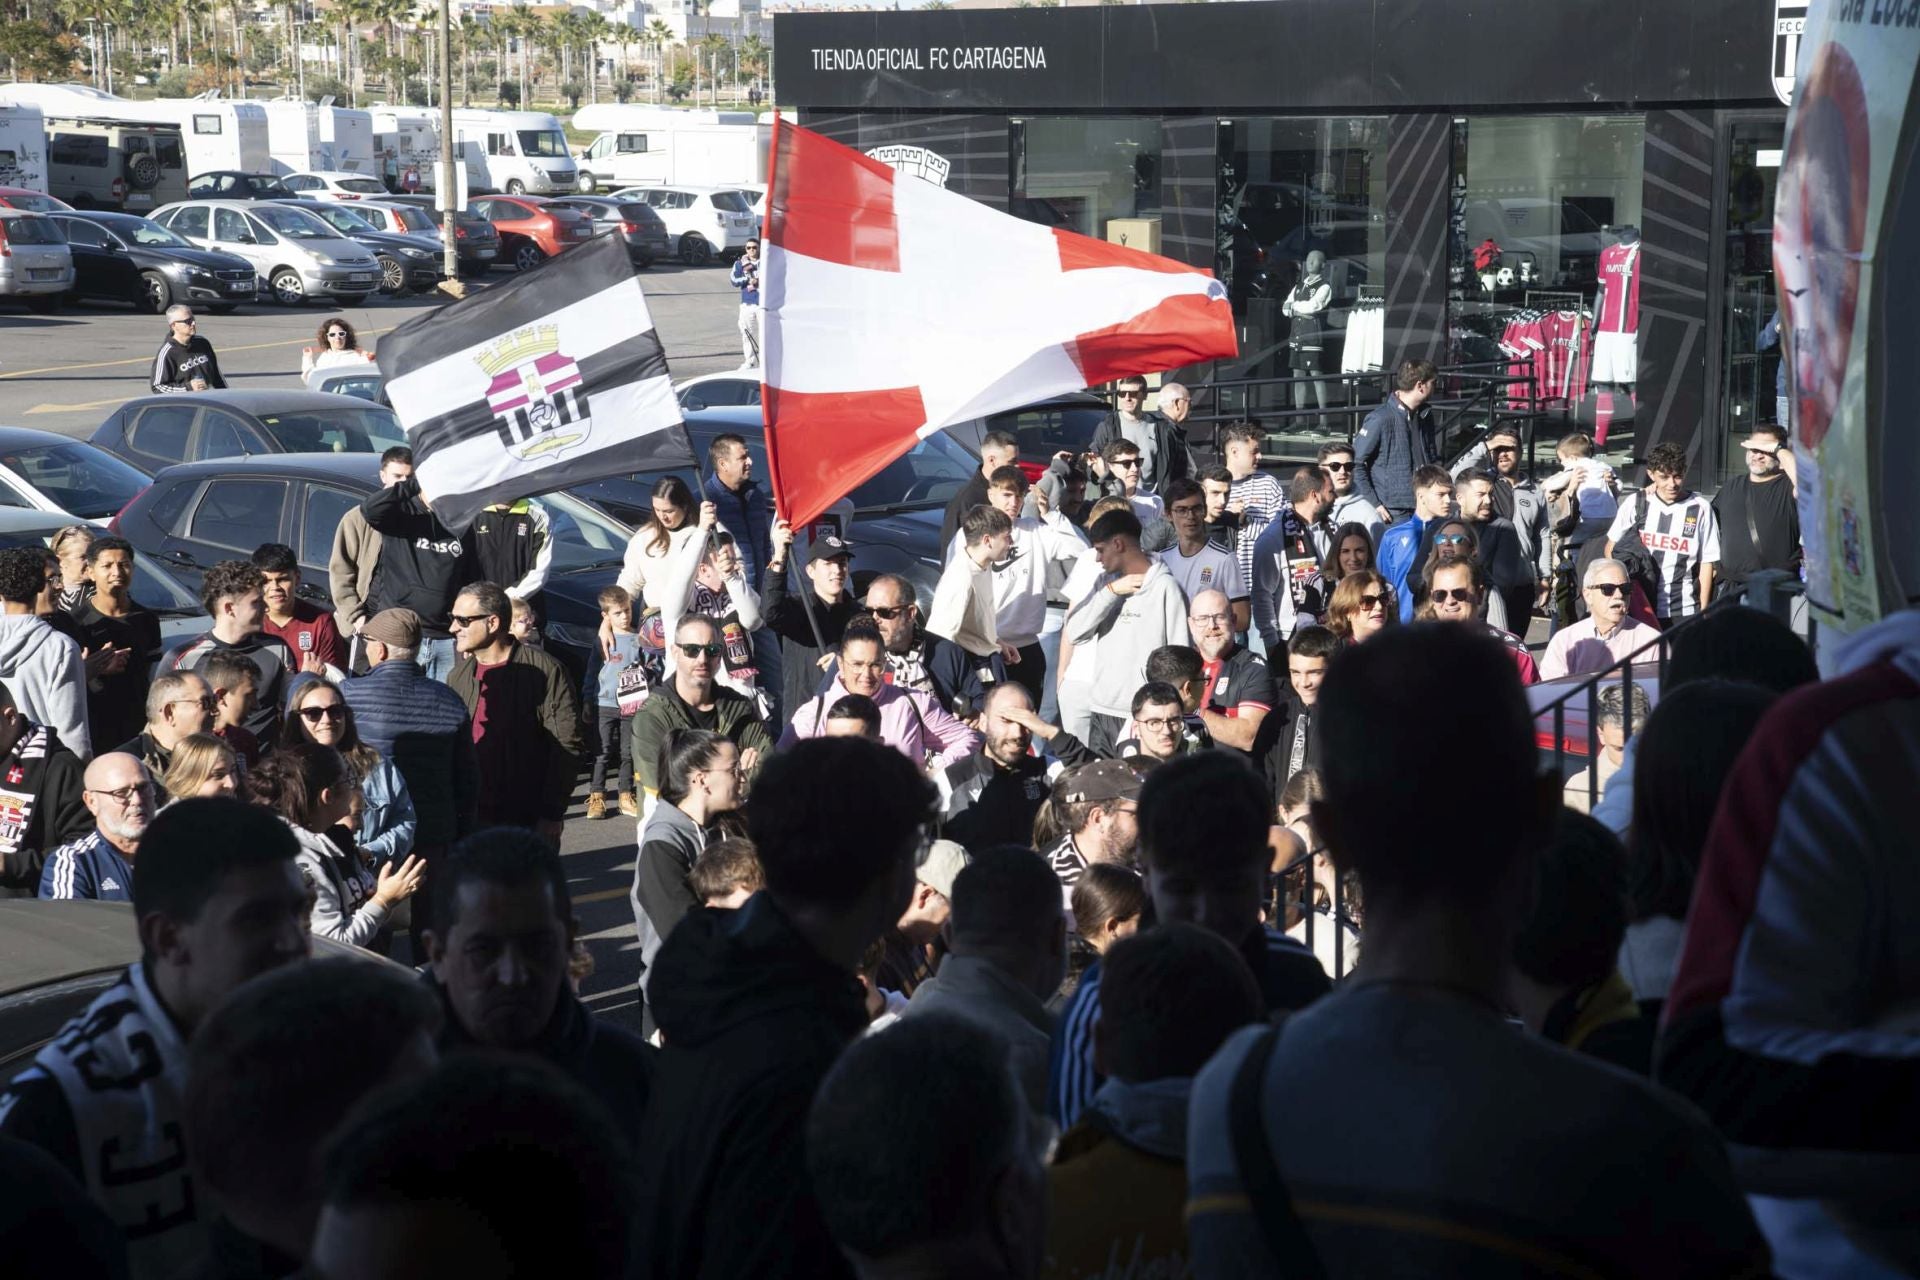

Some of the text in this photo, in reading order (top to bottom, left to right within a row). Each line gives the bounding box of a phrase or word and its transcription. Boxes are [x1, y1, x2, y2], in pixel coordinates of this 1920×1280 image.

[1778, 21, 1792, 33] FC
[811, 46, 1047, 70] TIENDA OFICIAL FC CARTAGENA
